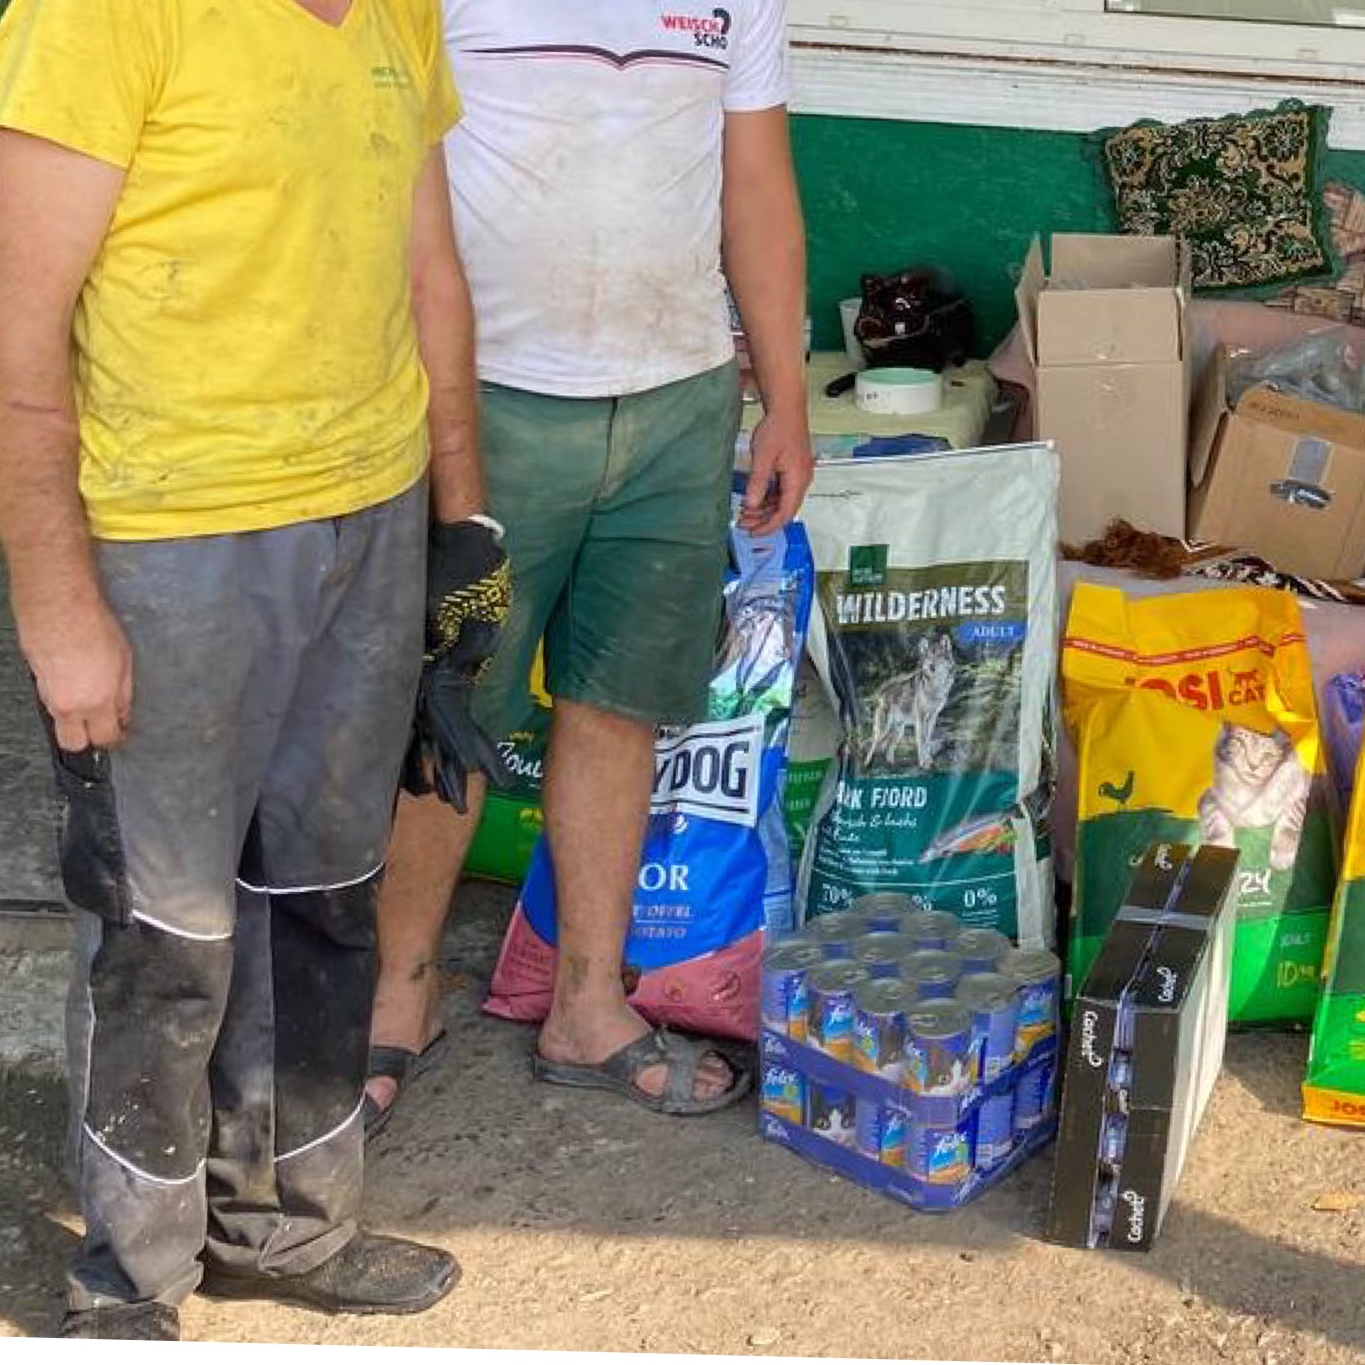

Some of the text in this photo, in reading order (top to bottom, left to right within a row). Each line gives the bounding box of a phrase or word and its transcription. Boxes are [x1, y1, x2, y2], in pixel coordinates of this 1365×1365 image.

[836, 585, 1006, 624] WILDERNESS
[669, 740, 750, 799] DOG
[871, 785, 928, 809] FJORD
